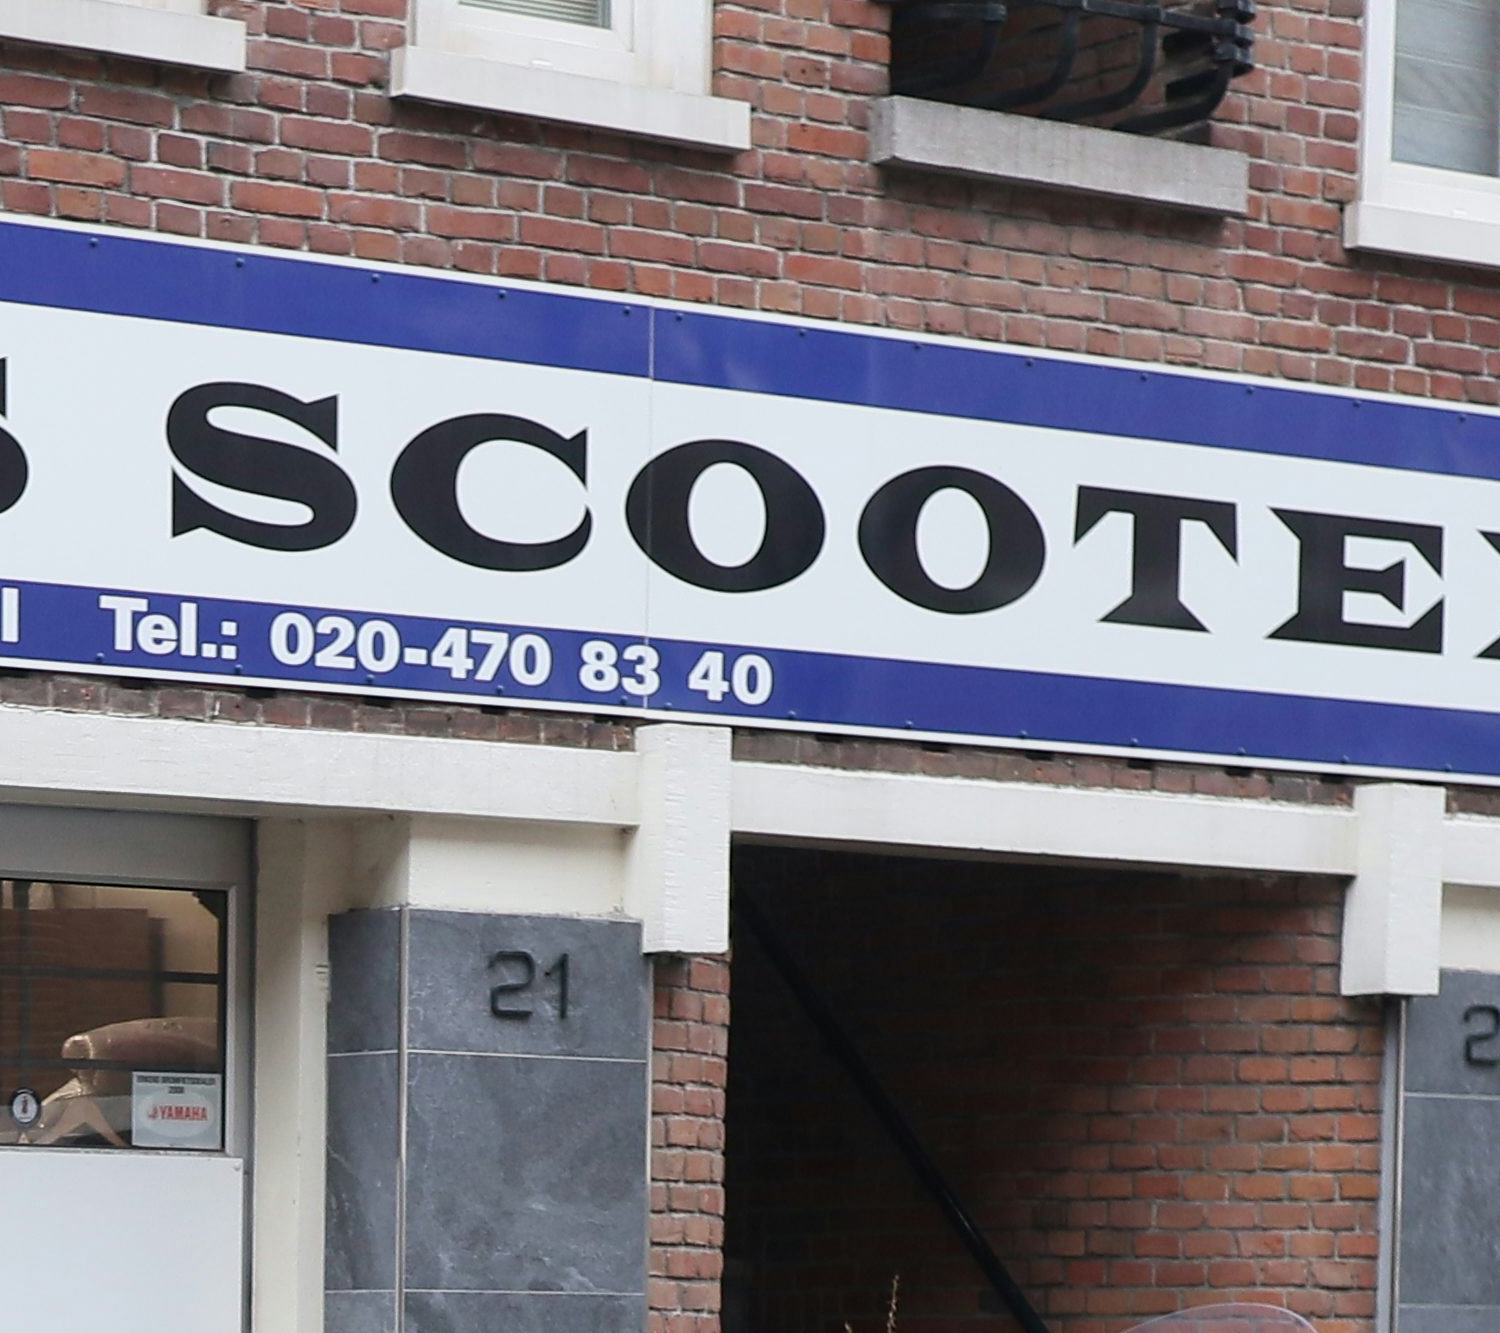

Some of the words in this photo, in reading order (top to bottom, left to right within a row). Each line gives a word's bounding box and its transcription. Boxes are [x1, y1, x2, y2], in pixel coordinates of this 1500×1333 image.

[99, 594, 239, 662] Tel.:
[269, 611, 552, 687] 020-470
[579, 640, 660, 697] 83
[687, 650, 775, 706] 40
[487, 950, 570, 1021] 21
[158, 1105, 208, 1121] YAMAHA
